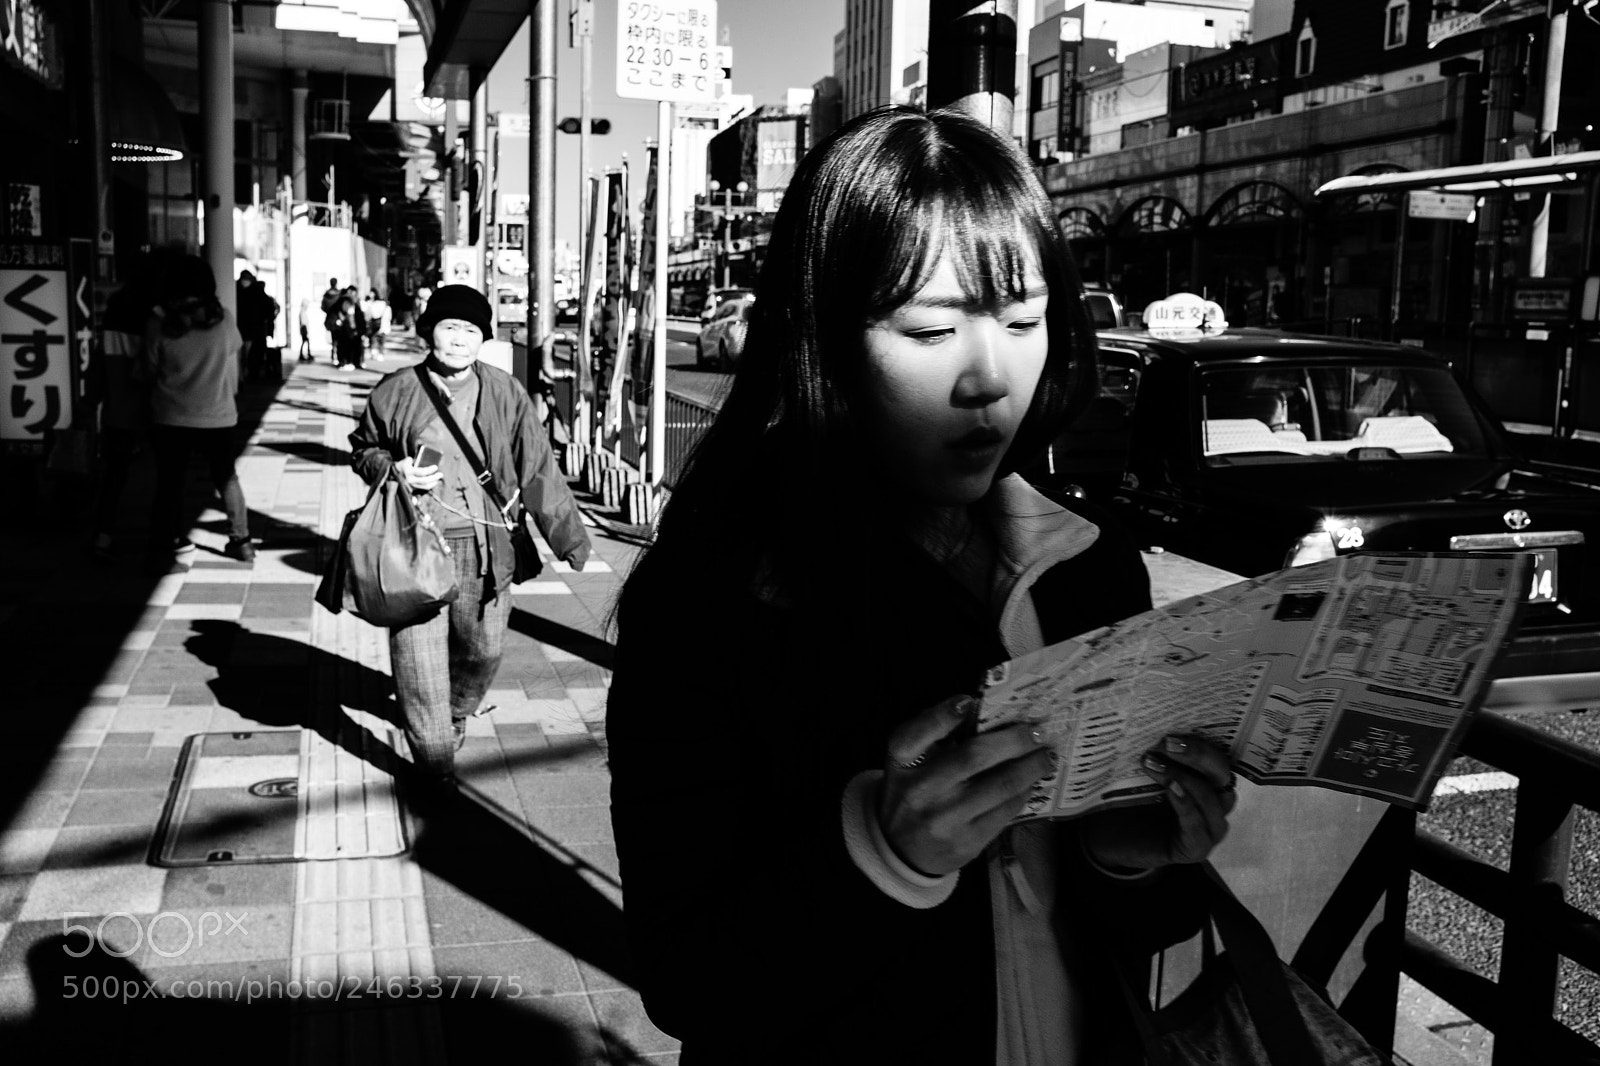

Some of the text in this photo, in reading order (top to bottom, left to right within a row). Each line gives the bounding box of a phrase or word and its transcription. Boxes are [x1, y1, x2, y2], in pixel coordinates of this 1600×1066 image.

[628, 2, 709, 27] タクシーに限る
[627, 24, 708, 49] 枠内に限る
[627, 68, 708, 92] ここまで
[1, 273, 66, 436] くすり
[1337, 526, 1365, 549] 28
